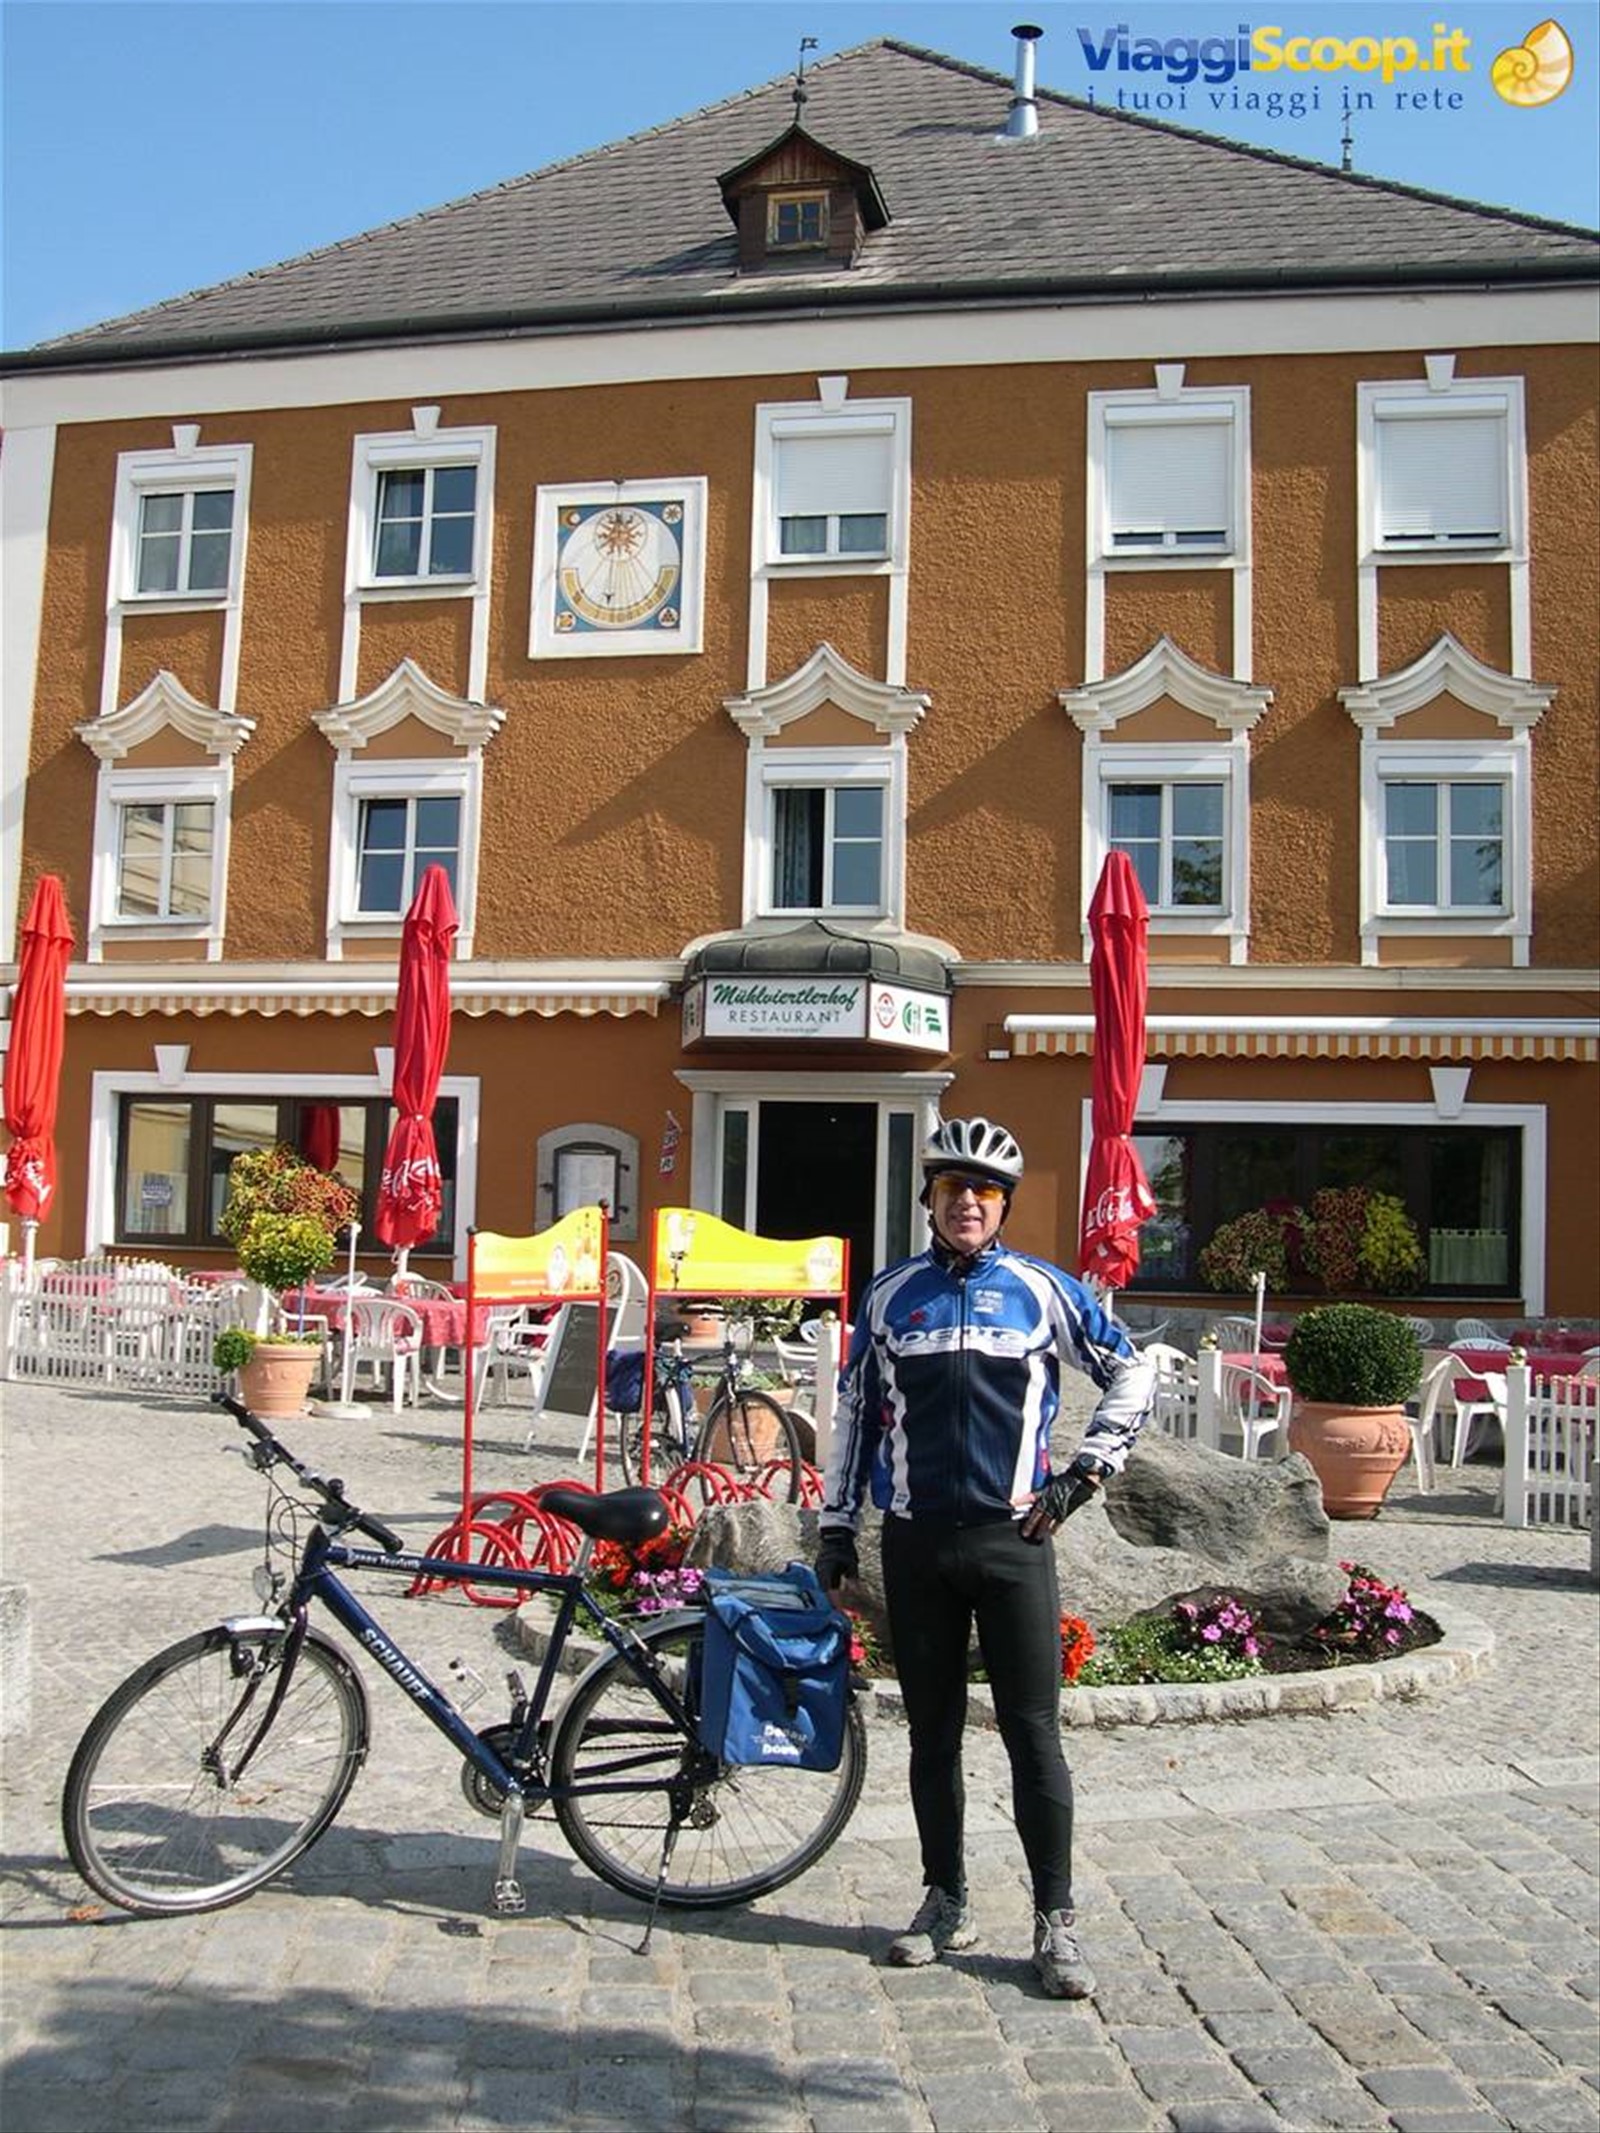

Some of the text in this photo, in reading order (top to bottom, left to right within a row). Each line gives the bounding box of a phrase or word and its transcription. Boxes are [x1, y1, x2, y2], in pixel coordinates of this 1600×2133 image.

[713, 984, 859, 1012] Mühlviertlerhof
[729, 1010, 841, 1024] RESTAURANT
[361, 1628, 431, 1699] SCHAUFF
